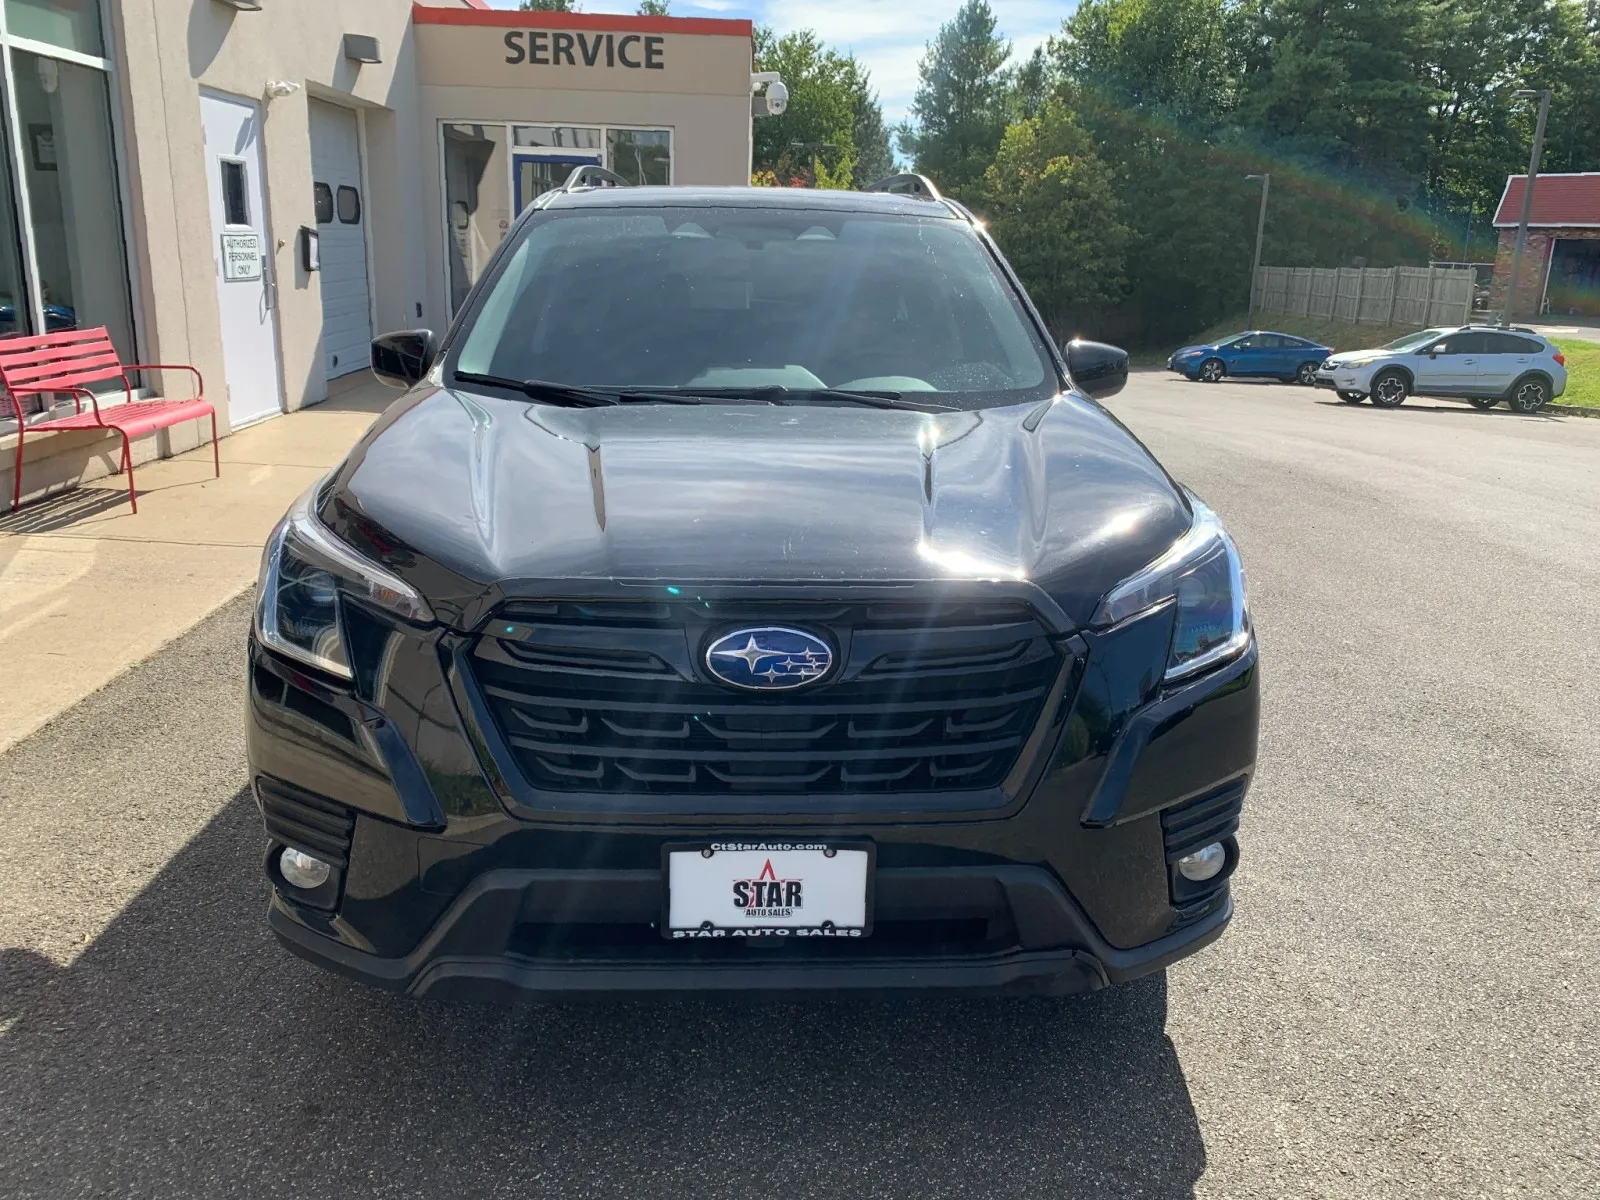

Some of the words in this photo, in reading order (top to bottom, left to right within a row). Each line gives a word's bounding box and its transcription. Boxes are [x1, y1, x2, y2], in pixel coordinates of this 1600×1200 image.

[504, 31, 665, 70] SERVICE
[226, 238, 257, 248] AUTHORIZED
[228, 252, 258, 262] PERSONNEL
[237, 264, 251, 275] ONLY
[710, 842, 828, 851] CtStarAuto.com
[732, 880, 803, 908] STAR
[745, 908, 767, 917] AUTO
[767, 908, 792, 917] SALES
[672, 929, 726, 938] STAR
[731, 928, 790, 937] AUTO
[796, 928, 862, 937] SALES
